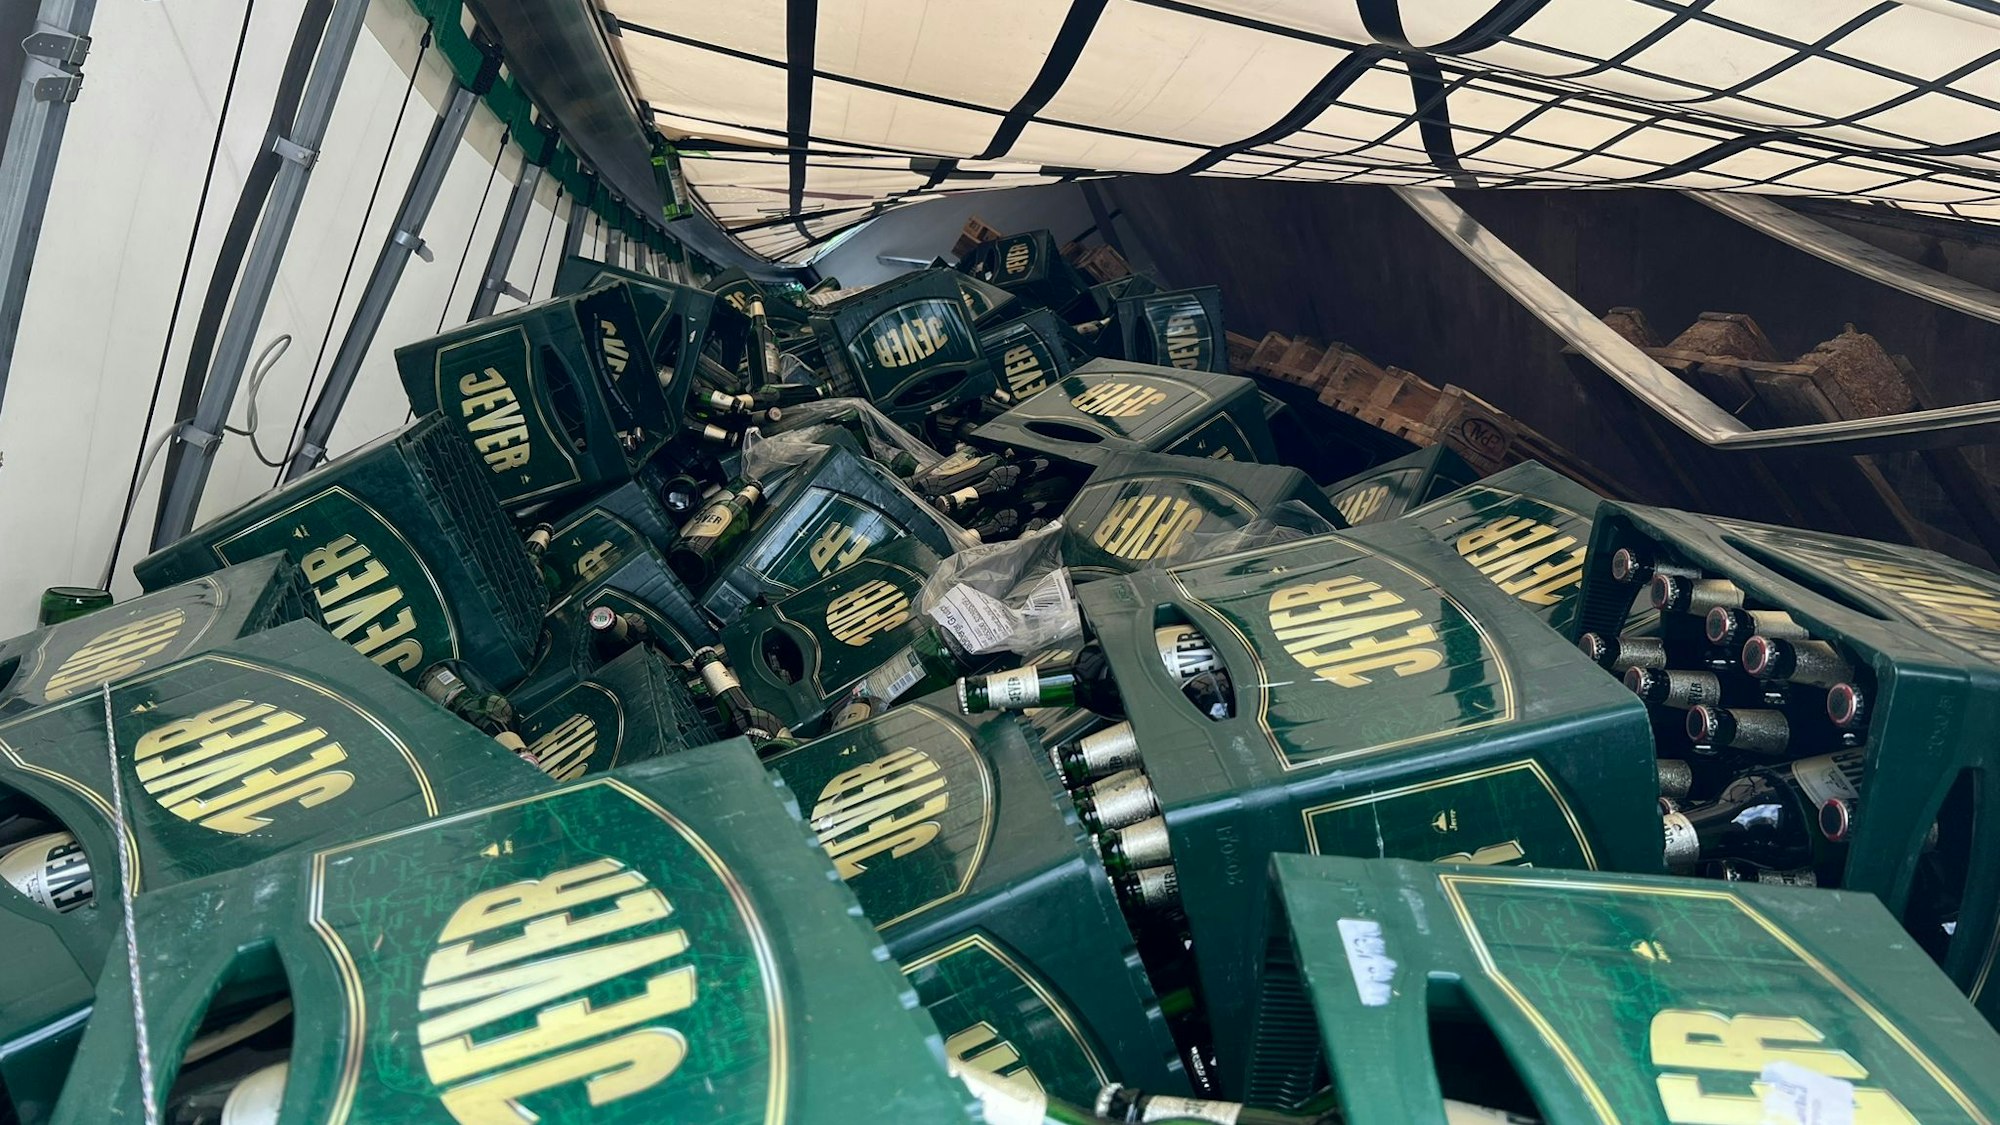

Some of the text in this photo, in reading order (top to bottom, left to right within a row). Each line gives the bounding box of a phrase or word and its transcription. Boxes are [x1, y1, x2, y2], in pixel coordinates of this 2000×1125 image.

[1006, 243, 1029, 274] JEVER
[872, 316, 948, 368] JEVER
[1004, 344, 1046, 400] EVER
[459, 367, 530, 474] JEVER
[1071, 382, 1168, 418] JEVER
[1094, 495, 1204, 560] JEVER
[301, 534, 424, 673] JEVER
[826, 580, 910, 647] JEVER
[1269, 574, 1444, 688] JEVER
[45, 607, 187, 701] JEVER
[1008, 677, 1022, 701] JEVER
[1177, 632, 1216, 681] EVER
[134, 699, 356, 834] JEVER
[810, 747, 949, 870] JEVER
[46, 841, 94, 914] EVER
[418, 858, 697, 1125] JEVER
